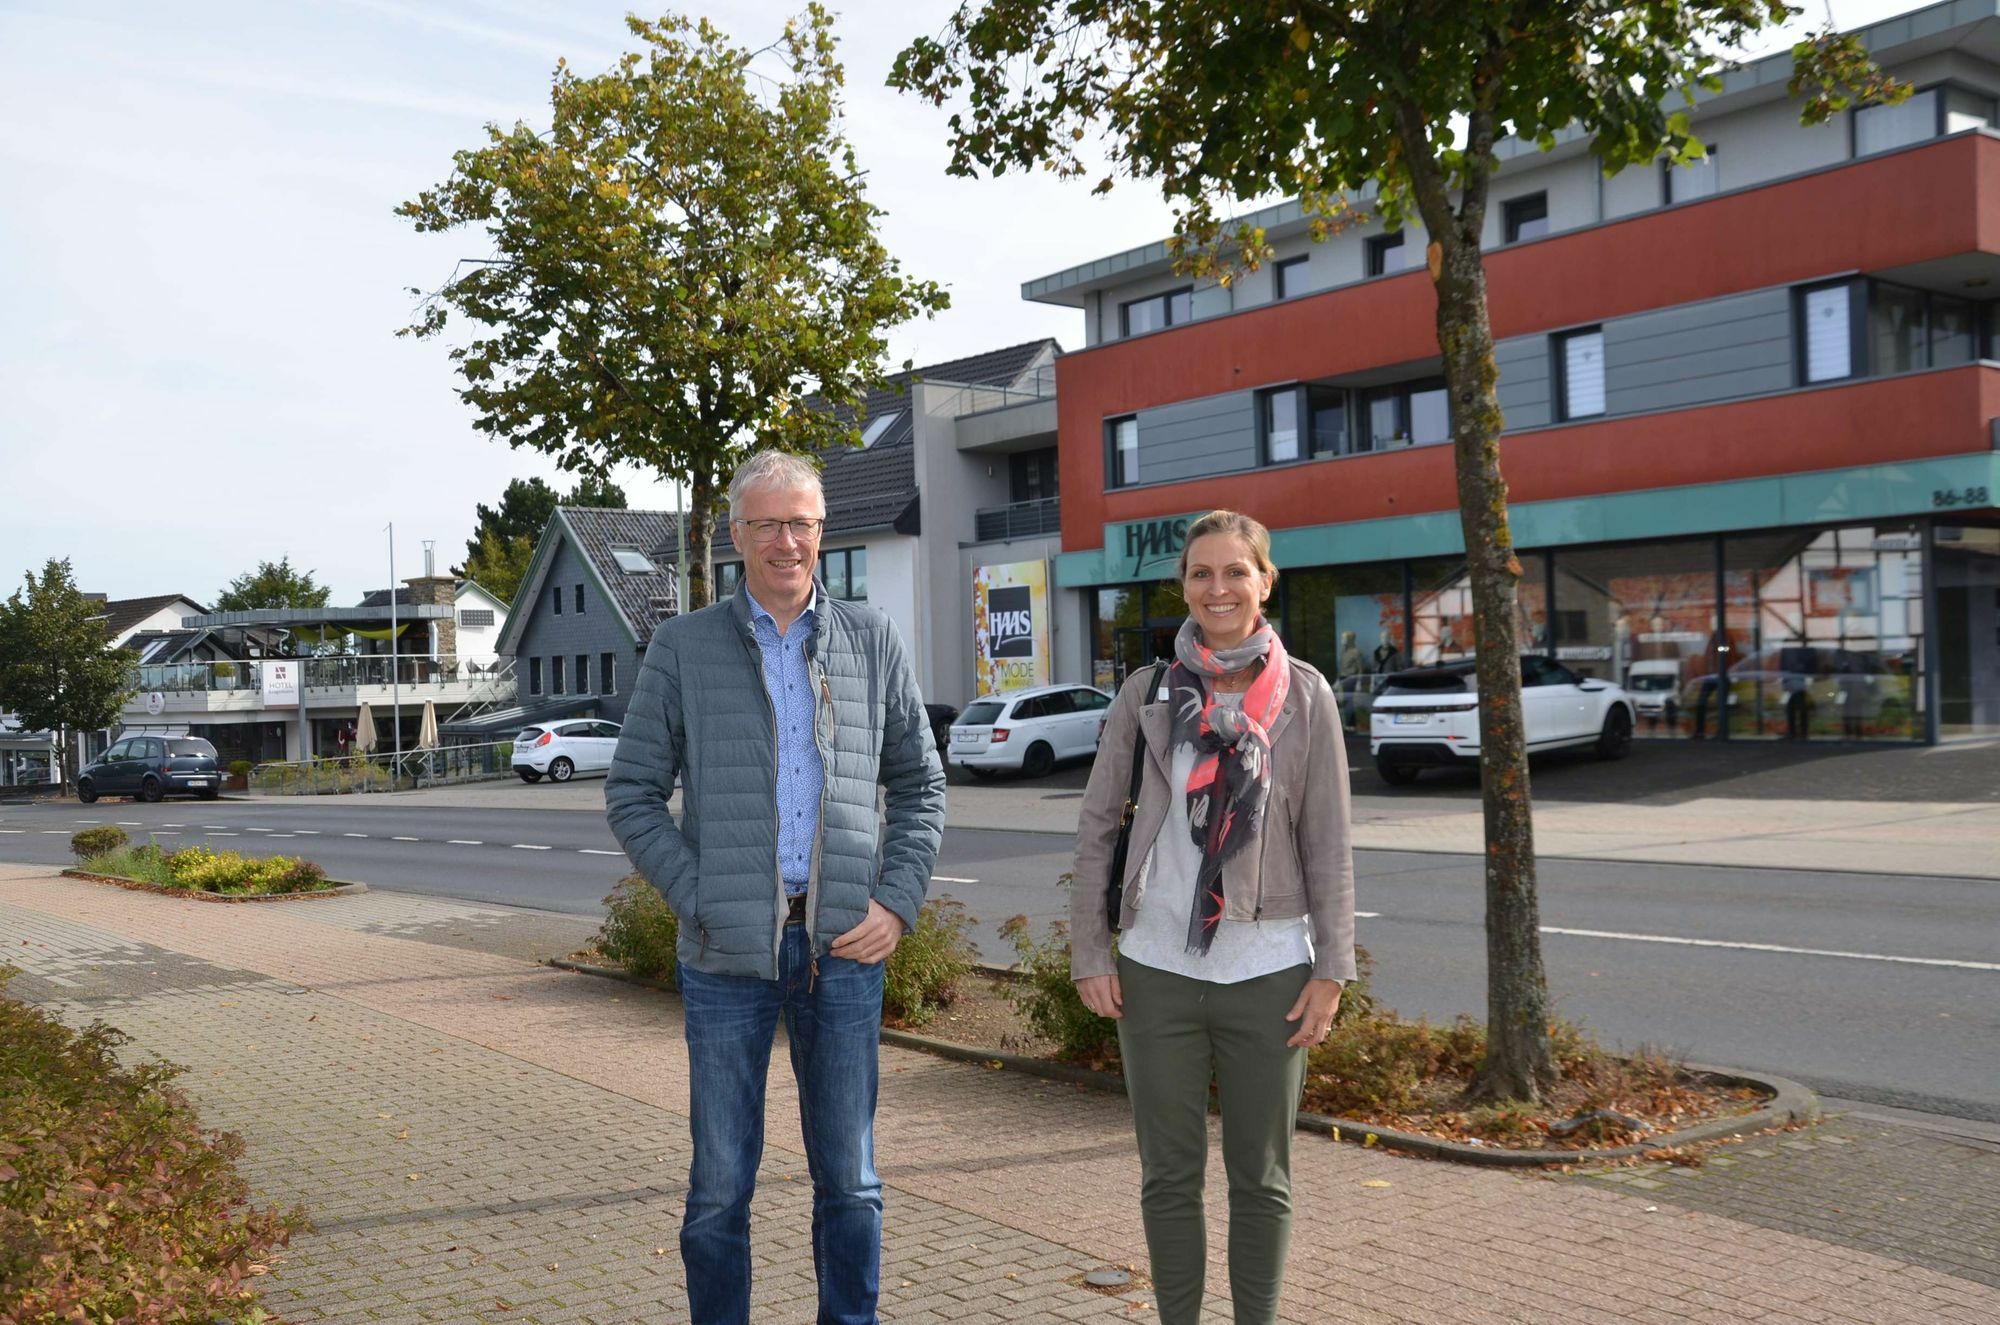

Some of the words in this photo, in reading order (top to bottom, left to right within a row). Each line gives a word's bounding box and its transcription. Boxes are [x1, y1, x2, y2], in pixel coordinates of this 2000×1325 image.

[1125, 519, 1187, 577] HAAS
[989, 609, 1031, 651] HAAS
[1001, 662, 1034, 678] MODE
[269, 681, 293, 689] HOTEL
